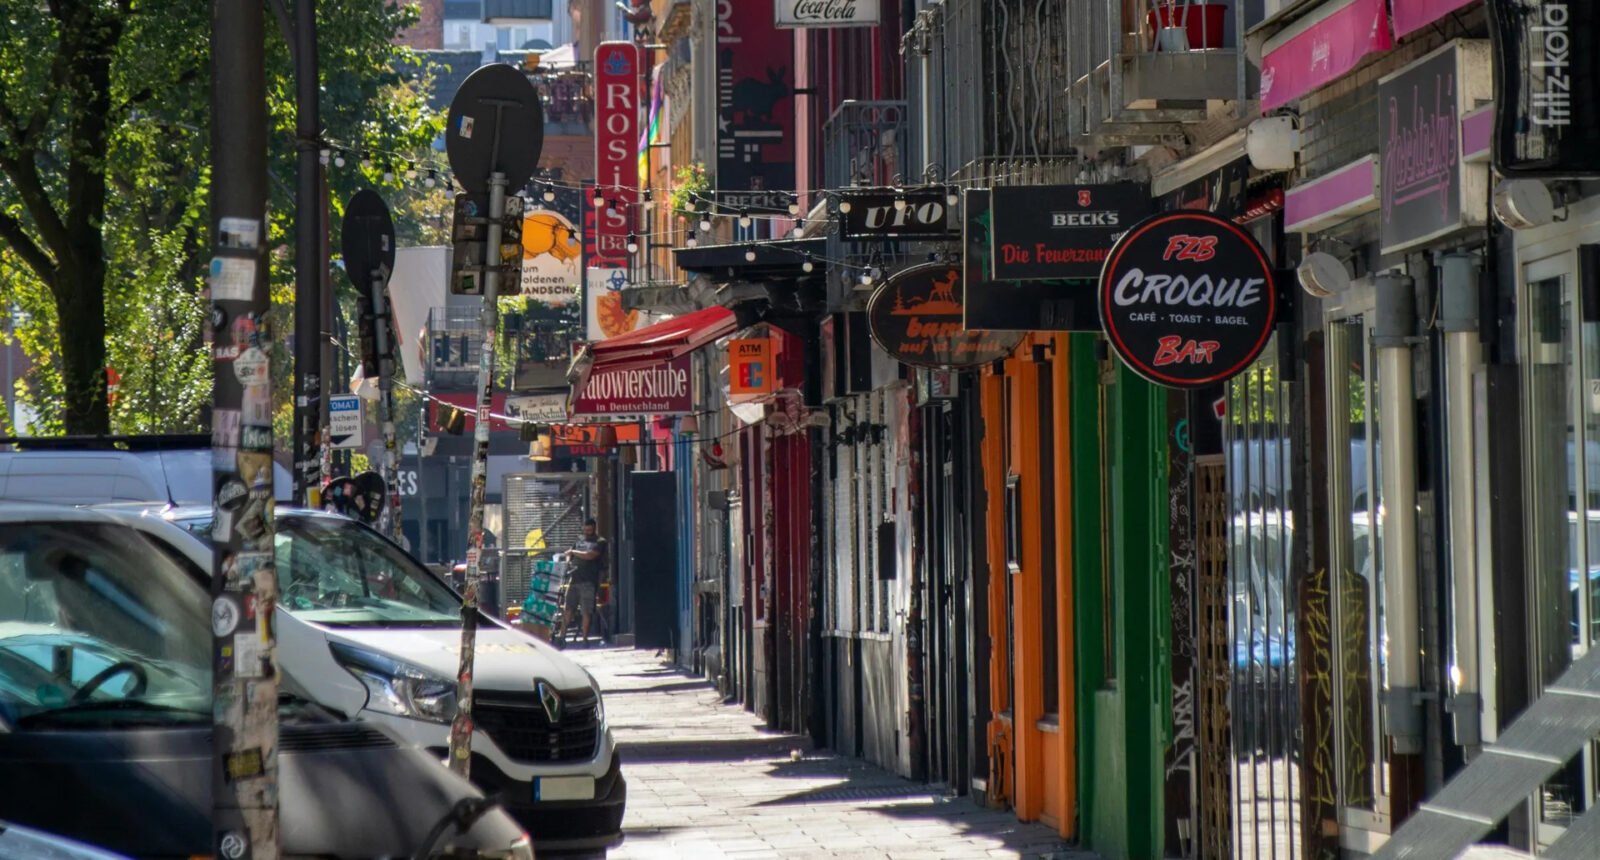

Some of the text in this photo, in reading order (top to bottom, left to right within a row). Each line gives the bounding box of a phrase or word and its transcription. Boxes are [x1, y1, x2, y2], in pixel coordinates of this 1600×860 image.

[793, 0, 856, 20] Coca-Cola
[1531, 4, 1571, 128] fritz-kola
[865, 202, 943, 229] UFO
[1052, 210, 1119, 226] BECK'S
[601, 236, 627, 250] Ba
[1163, 235, 1219, 262] FZB
[1002, 244, 1029, 265] Die
[522, 275, 564, 283] oldenen
[1114, 268, 1265, 307] CROQUE
[521, 286, 576, 295] ANDSCHU
[1129, 311, 1248, 325] CAFÉ TOAST BAGEL
[739, 343, 762, 353] ATM
[1153, 335, 1220, 366] BAR
[739, 362, 762, 388] EC
[596, 401, 670, 412] in Deutschland
[397, 470, 418, 496] ES
